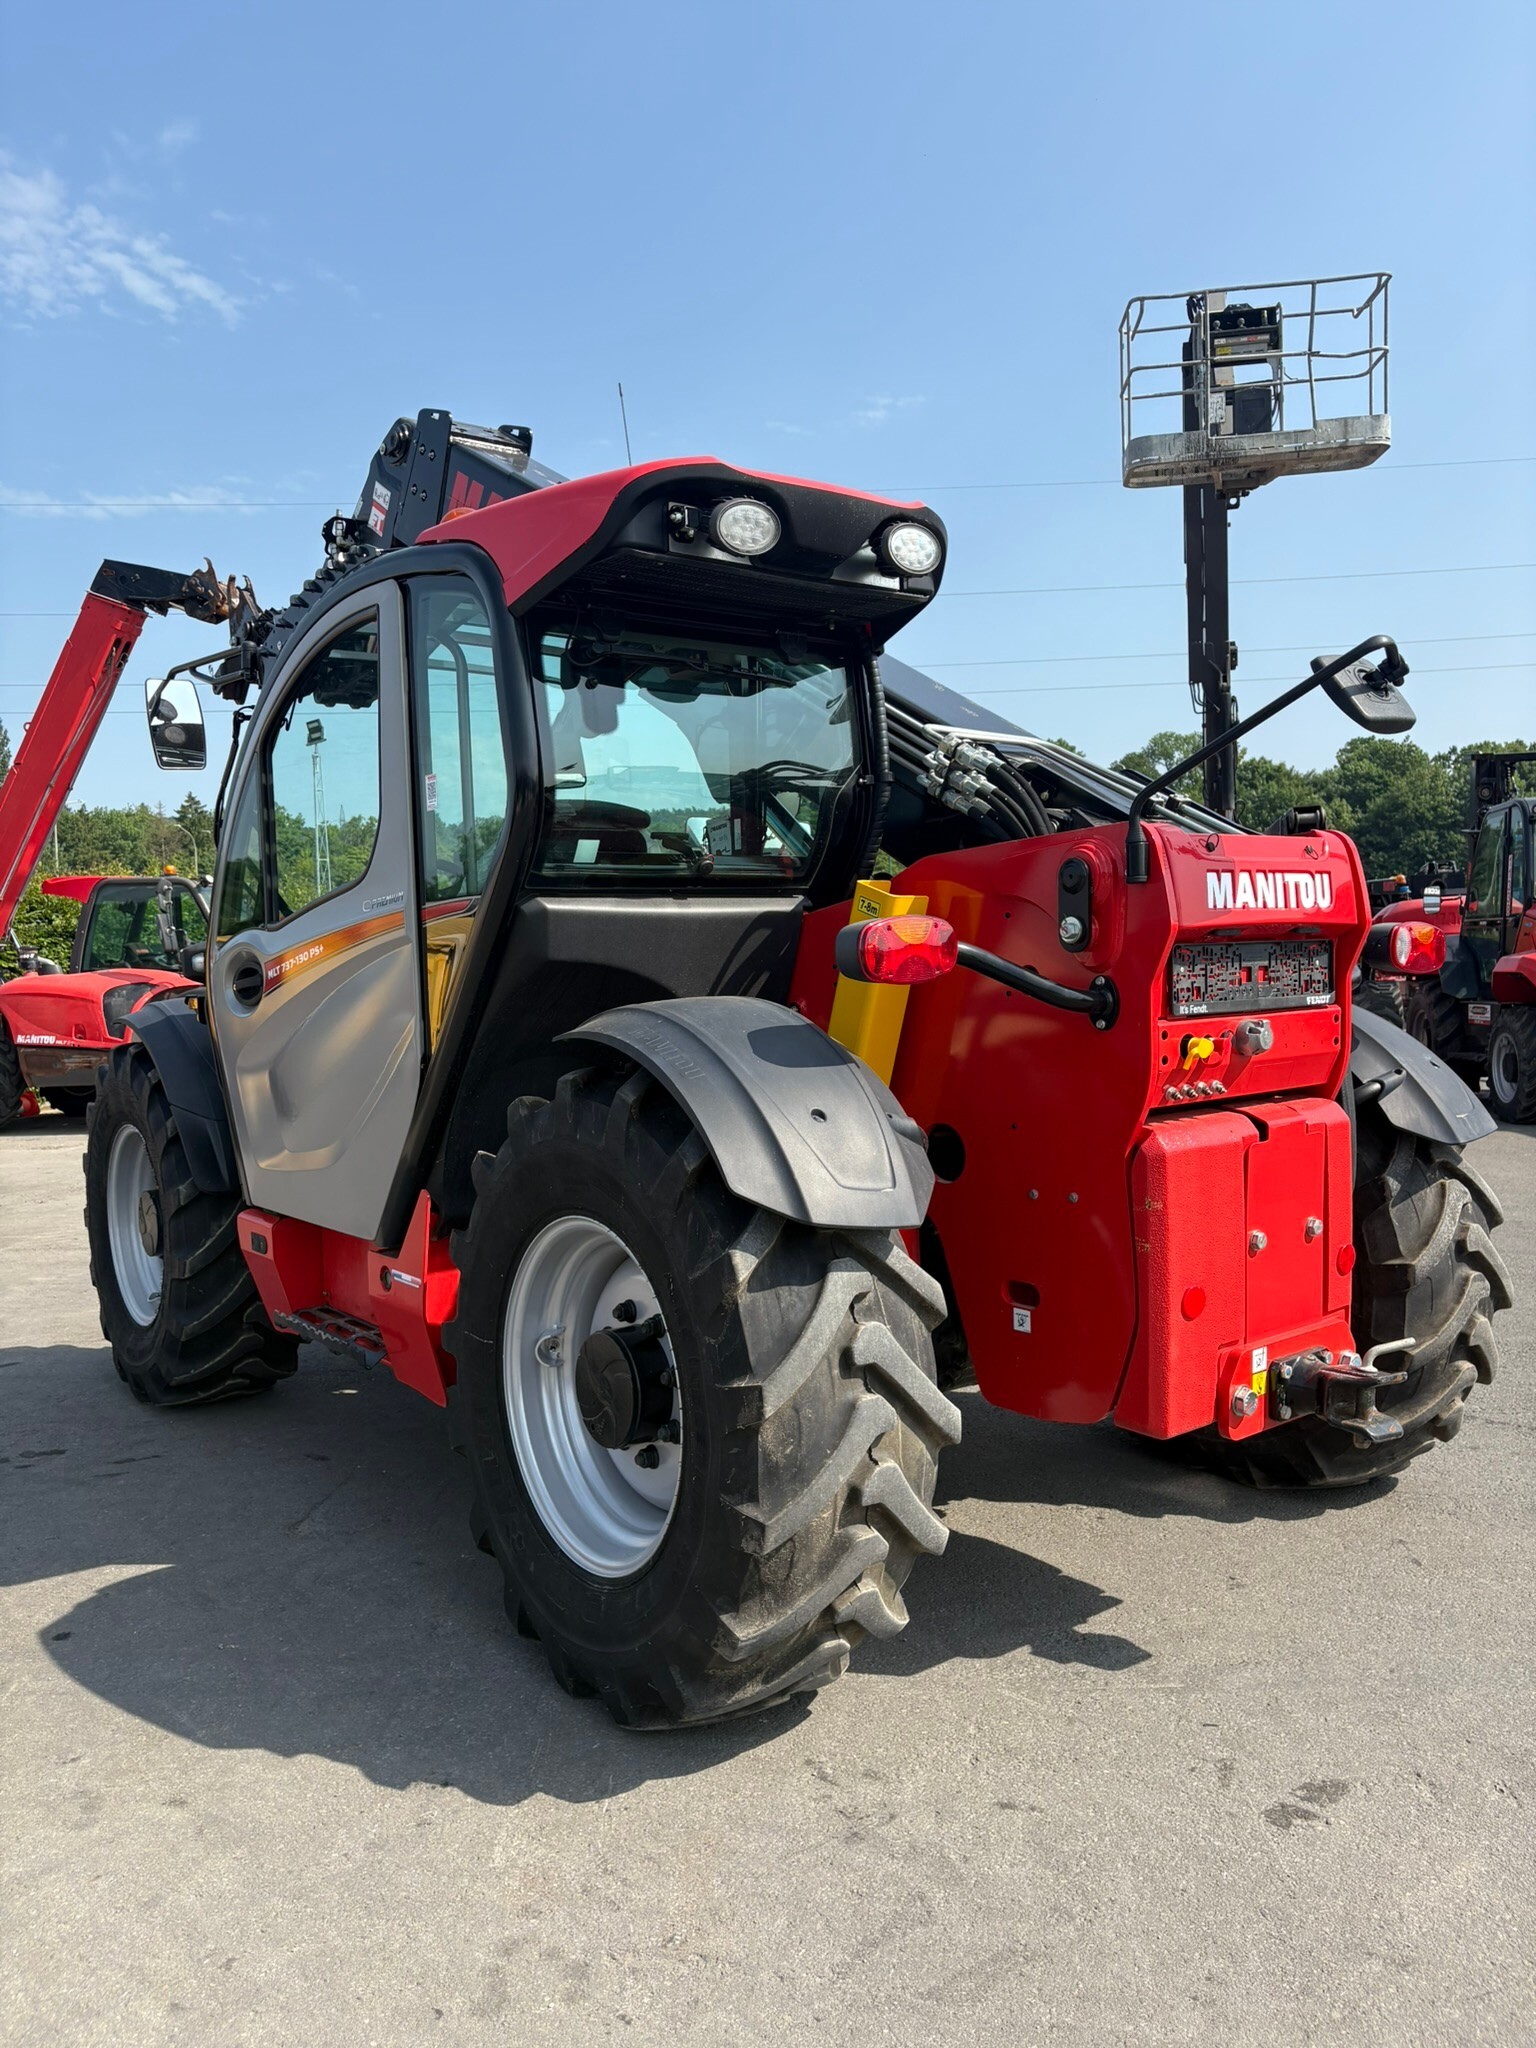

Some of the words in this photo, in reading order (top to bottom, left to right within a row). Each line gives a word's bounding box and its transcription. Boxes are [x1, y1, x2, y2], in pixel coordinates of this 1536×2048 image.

[1206, 871, 1332, 910] MANITOU
[371, 891, 404, 909] PREMIUM
[860, 899, 878, 915] 7-8m
[268, 965, 281, 980] MLT
[281, 952, 309, 973] 737-130
[310, 944, 324, 958] PS+
[1306, 995, 1331, 1005] FENDT
[1179, 1005, 1189, 1014] It's
[16, 1034, 56, 1044] MANITOU
